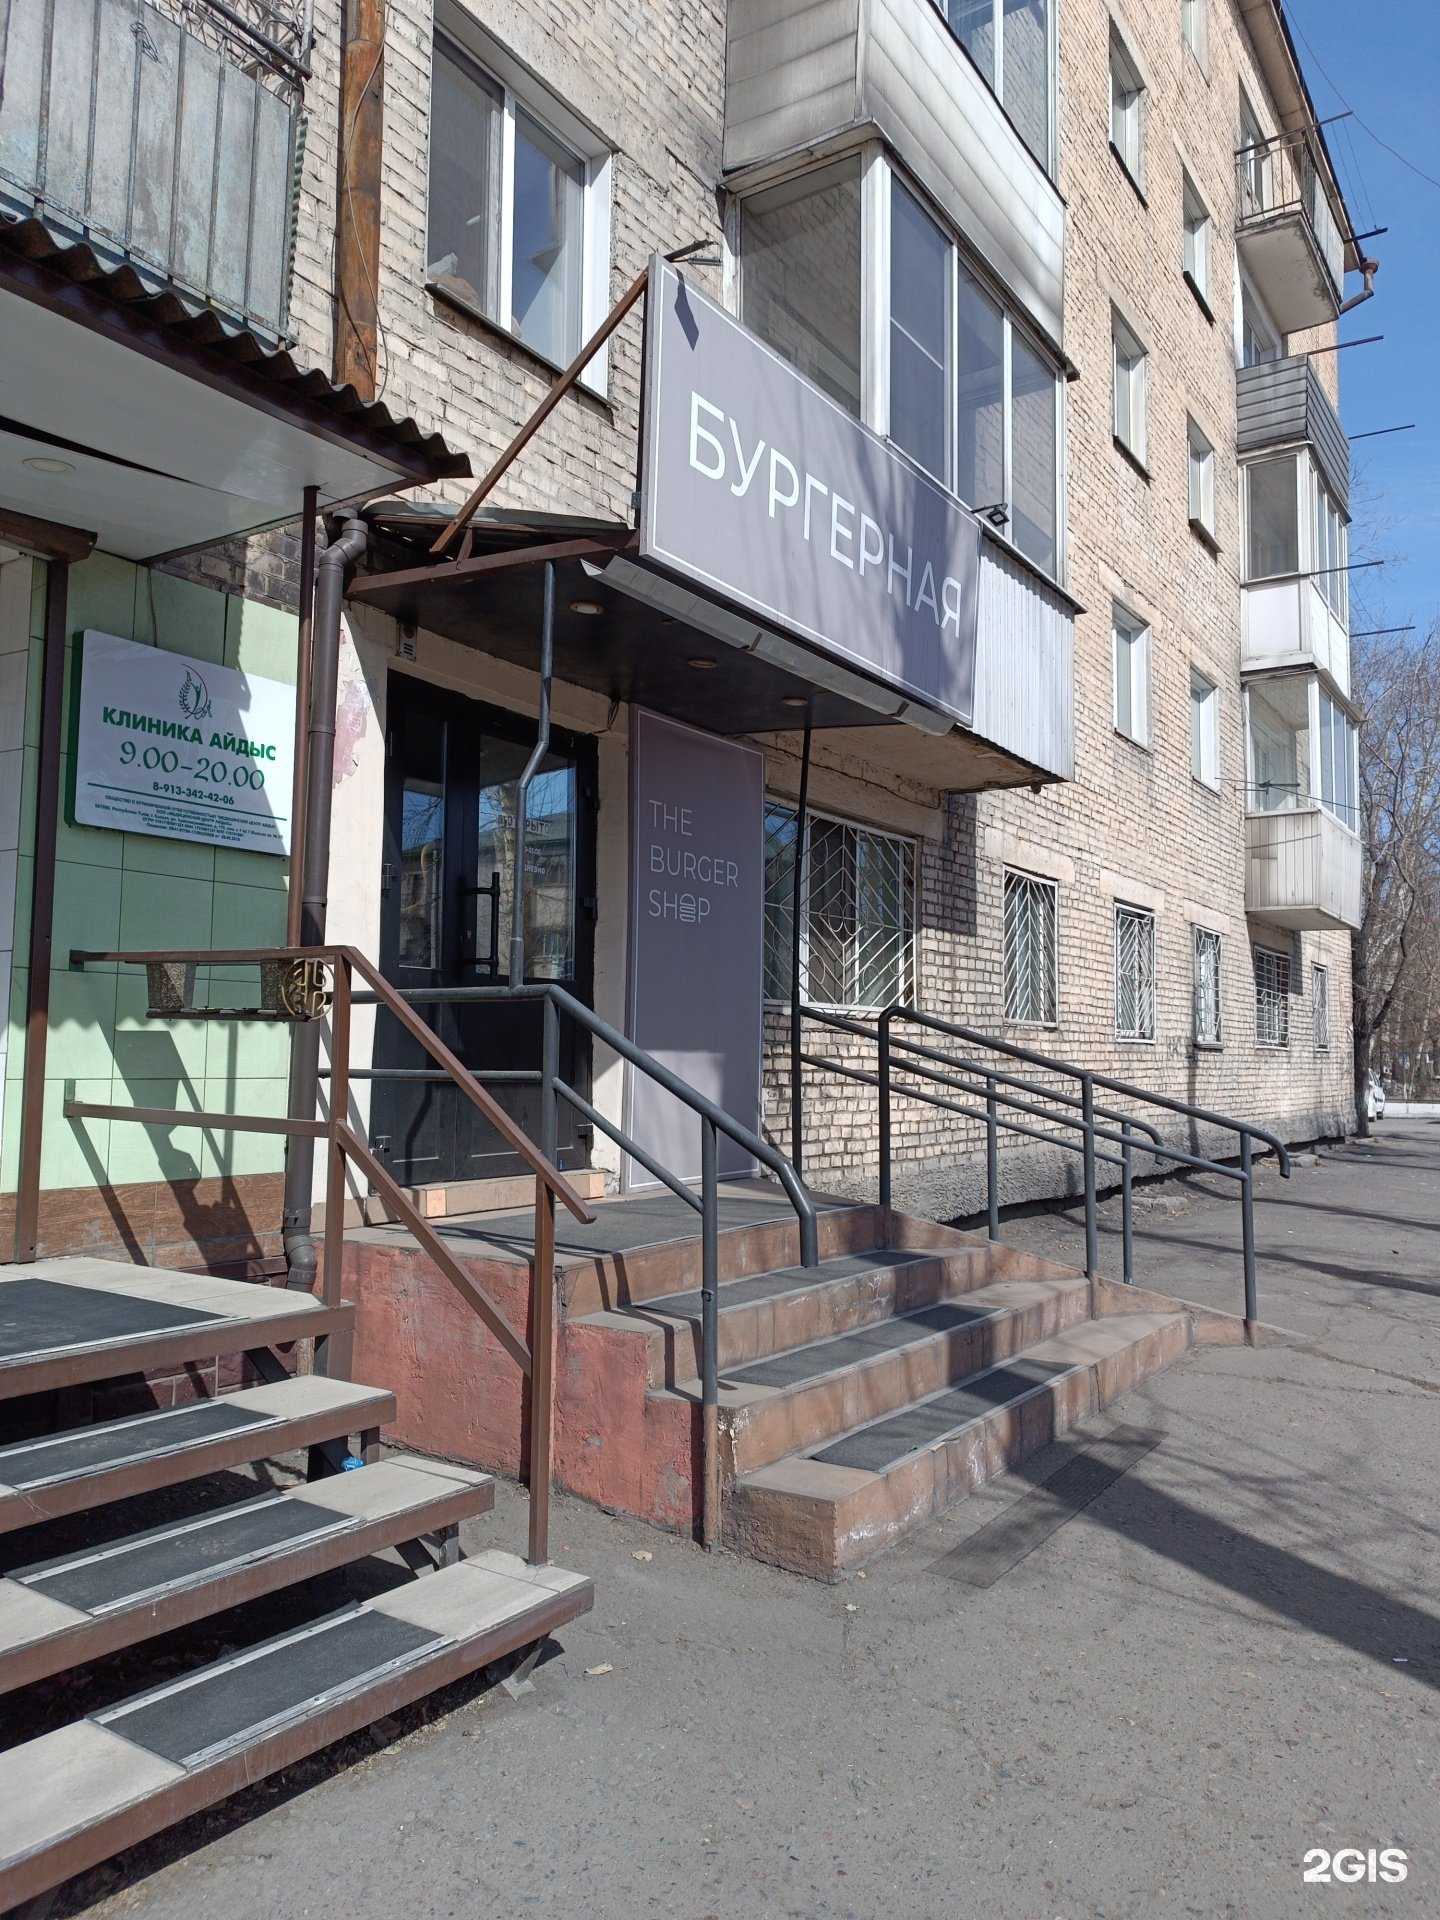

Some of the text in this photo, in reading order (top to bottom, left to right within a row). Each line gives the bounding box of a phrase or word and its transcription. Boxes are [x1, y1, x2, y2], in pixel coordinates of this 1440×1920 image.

[689, 390, 962, 639] БУРГЕРНАЯ
[102, 706, 276, 761] КЛИНИКА АЙДЫС
[152, 781, 235, 806] 8-913-342-42-06
[649, 799, 693, 836] THE
[650, 844, 739, 888] BURGER
[648, 889, 711, 923] SHOP
